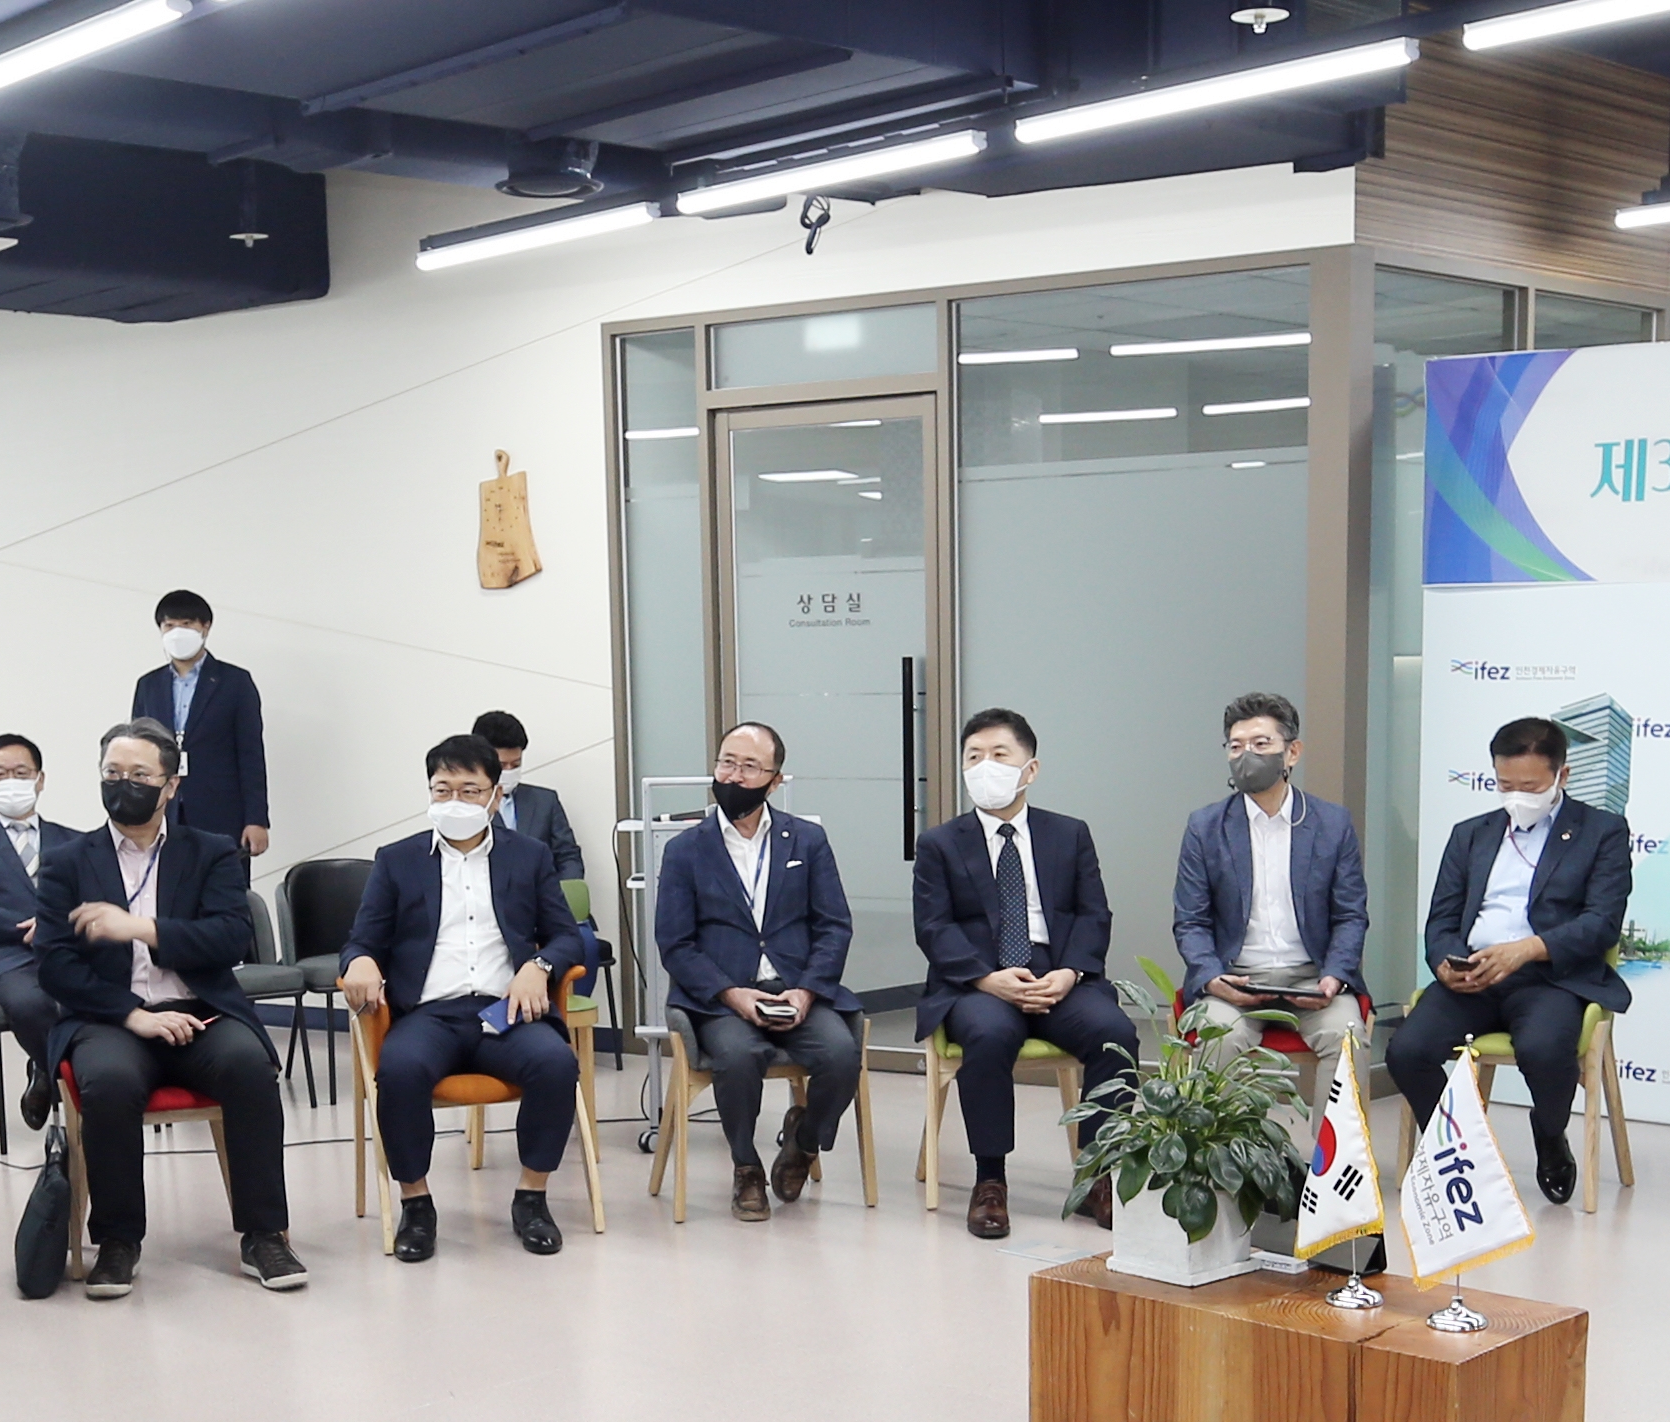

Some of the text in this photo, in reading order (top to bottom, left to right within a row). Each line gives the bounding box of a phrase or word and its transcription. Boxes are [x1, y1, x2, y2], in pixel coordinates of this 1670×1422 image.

[789, 618, 870, 627] Consultation Room
[1473, 661, 1510, 681] ifez
[1471, 772, 1496, 792] ife
[1618, 1060, 1656, 1082] ifez
[1434, 1142, 1483, 1232] ifez
[1423, 1221, 1435, 1245] Zone
